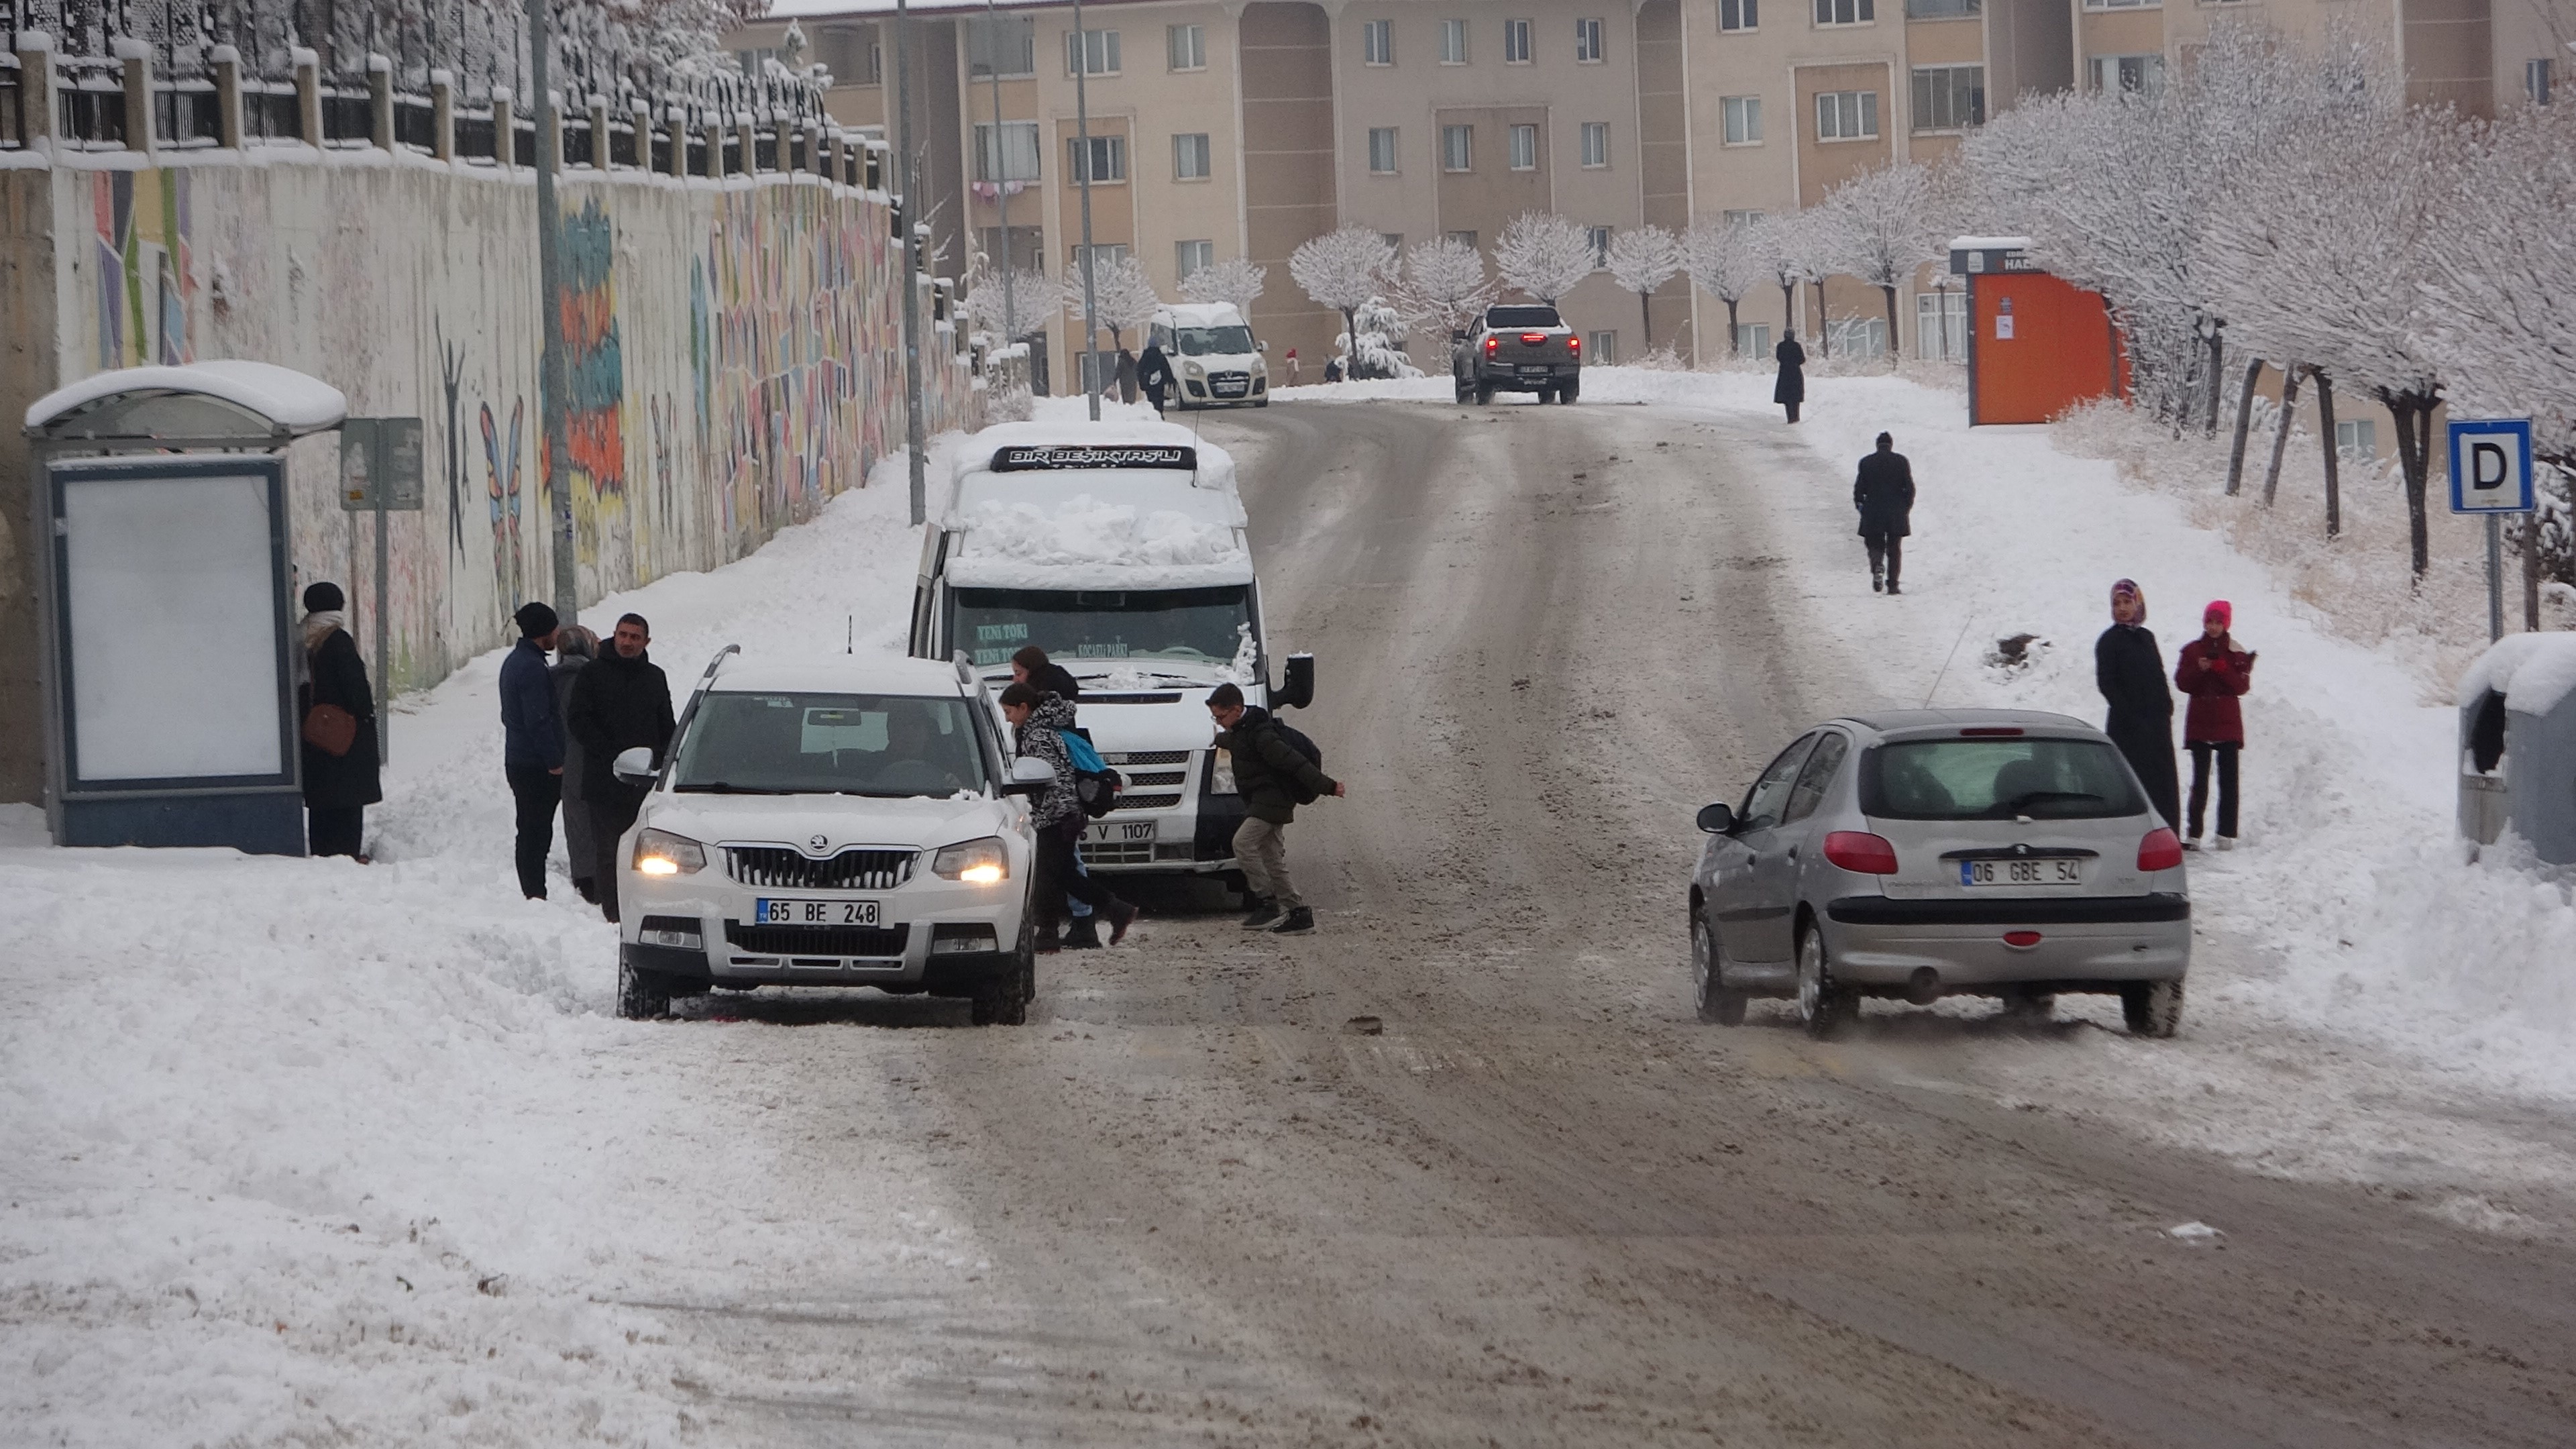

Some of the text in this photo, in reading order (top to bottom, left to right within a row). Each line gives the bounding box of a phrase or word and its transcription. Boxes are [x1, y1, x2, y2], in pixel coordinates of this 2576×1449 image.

[2472, 442, 2508, 490] D
[1097, 824, 1109, 841] V
[1121, 822, 1152, 840] 1107
[1972, 863, 1994, 882] 06
[2010, 861, 2042, 881] GBE
[769, 902, 790, 922] 65
[805, 903, 827, 922] BE
[844, 904, 876, 924] 248
